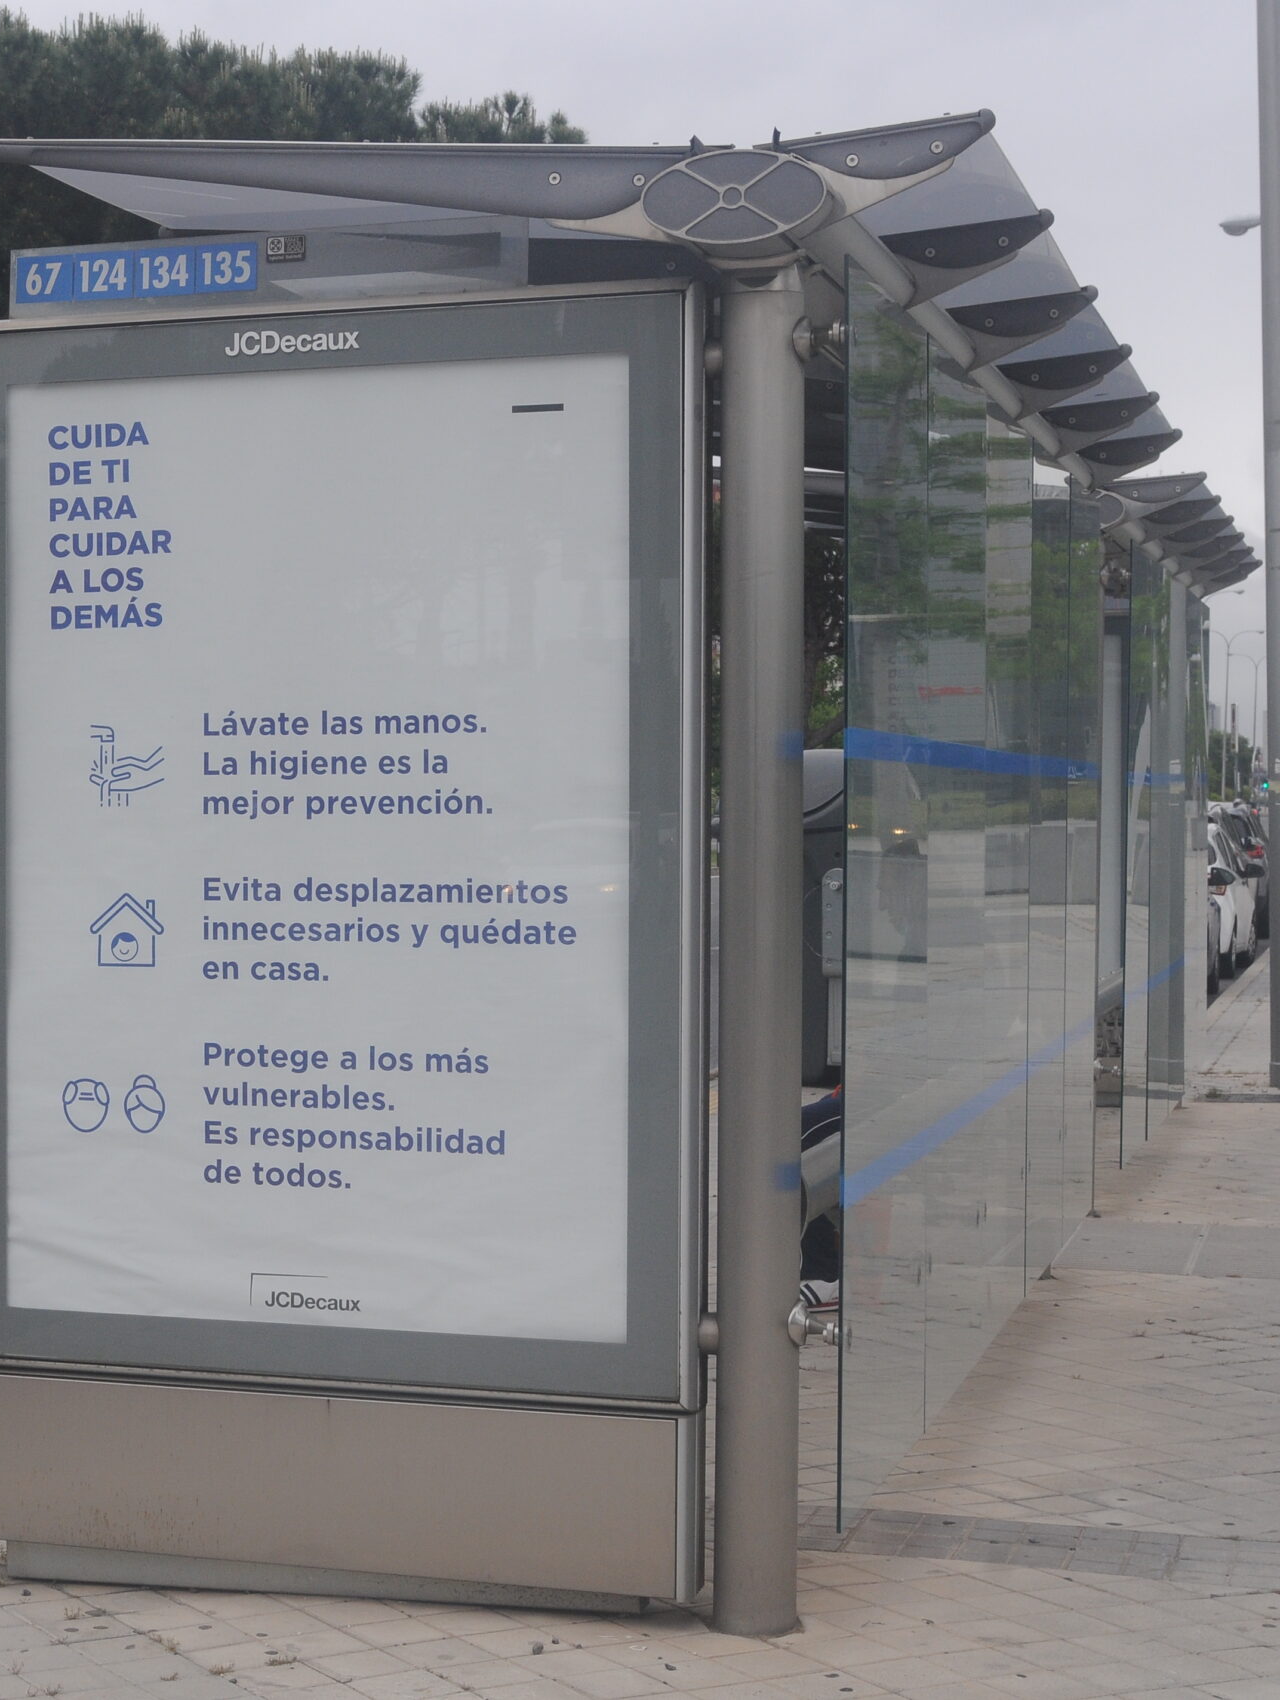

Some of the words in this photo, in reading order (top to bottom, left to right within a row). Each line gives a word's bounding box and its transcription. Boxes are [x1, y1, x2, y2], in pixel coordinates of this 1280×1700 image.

[24, 262, 63, 297] 67
[79, 258, 128, 293] 124
[139, 254, 189, 290] 134
[200, 249, 252, 285] 135
[224, 330, 360, 357] JCDecaux
[47, 421, 150, 451] CUIDA
[48, 460, 92, 486] DE
[101, 458, 130, 484] TI
[49, 494, 137, 522] PARA
[49, 529, 172, 559] CUIDAR
[48, 569, 74, 594] A
[83, 566, 144, 593] LOS
[49, 596, 163, 630] DEMÁS
[203, 710, 309, 737] Lávate
[321, 710, 363, 736] las
[374, 713, 487, 735] manos.
[203, 751, 238, 776] La
[250, 749, 368, 781] higiene
[378, 755, 412, 775] es
[423, 748, 448, 774] la
[203, 789, 295, 820] mejor
[306, 787, 493, 820] prevención.
[203, 876, 281, 902] Evita
[293, 876, 568, 908] desplazamientos
[203, 915, 400, 943] innecesarios
[410, 923, 429, 949] y
[440, 917, 577, 949] quédate
[202, 960, 239, 980] en
[250, 961, 329, 982] casa.
[203, 1042, 329, 1074] Protege
[340, 1050, 357, 1070] a
[369, 1045, 414, 1072] los
[425, 1047, 489, 1074] más
[203, 1081, 395, 1111] vulnerables.
[204, 1120, 238, 1145] Es
[249, 1125, 506, 1156] responsabilidad
[203, 1158, 242, 1185] de
[252, 1162, 351, 1189] todos.
[264, 1291, 361, 1312] JCDecaux
